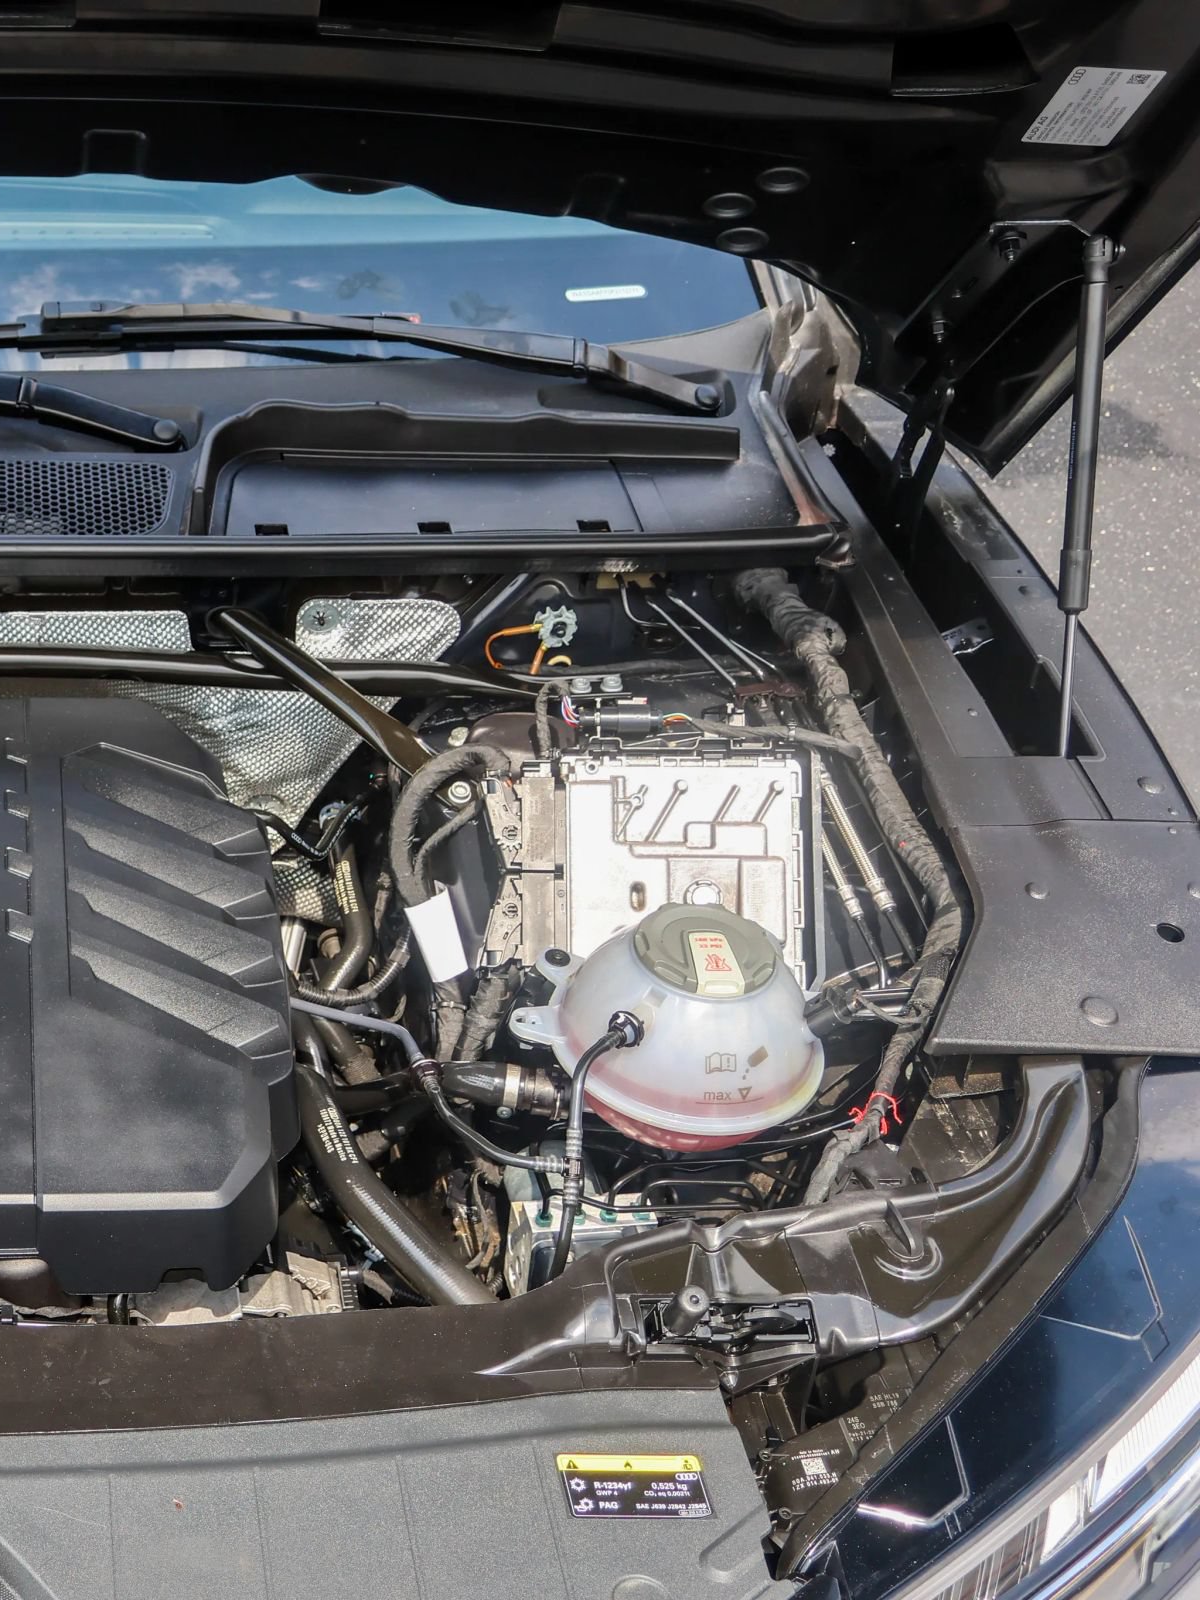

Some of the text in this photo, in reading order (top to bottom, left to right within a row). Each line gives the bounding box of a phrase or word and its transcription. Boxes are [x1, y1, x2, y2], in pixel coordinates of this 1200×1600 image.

[1026, 116, 1049, 140] AUDI AG
[703, 1089, 732, 1101] max
[593, 1481, 632, 1491] R-1234yf
[676, 1482, 688, 1491] kg
[599, 1501, 619, 1510] PAG
